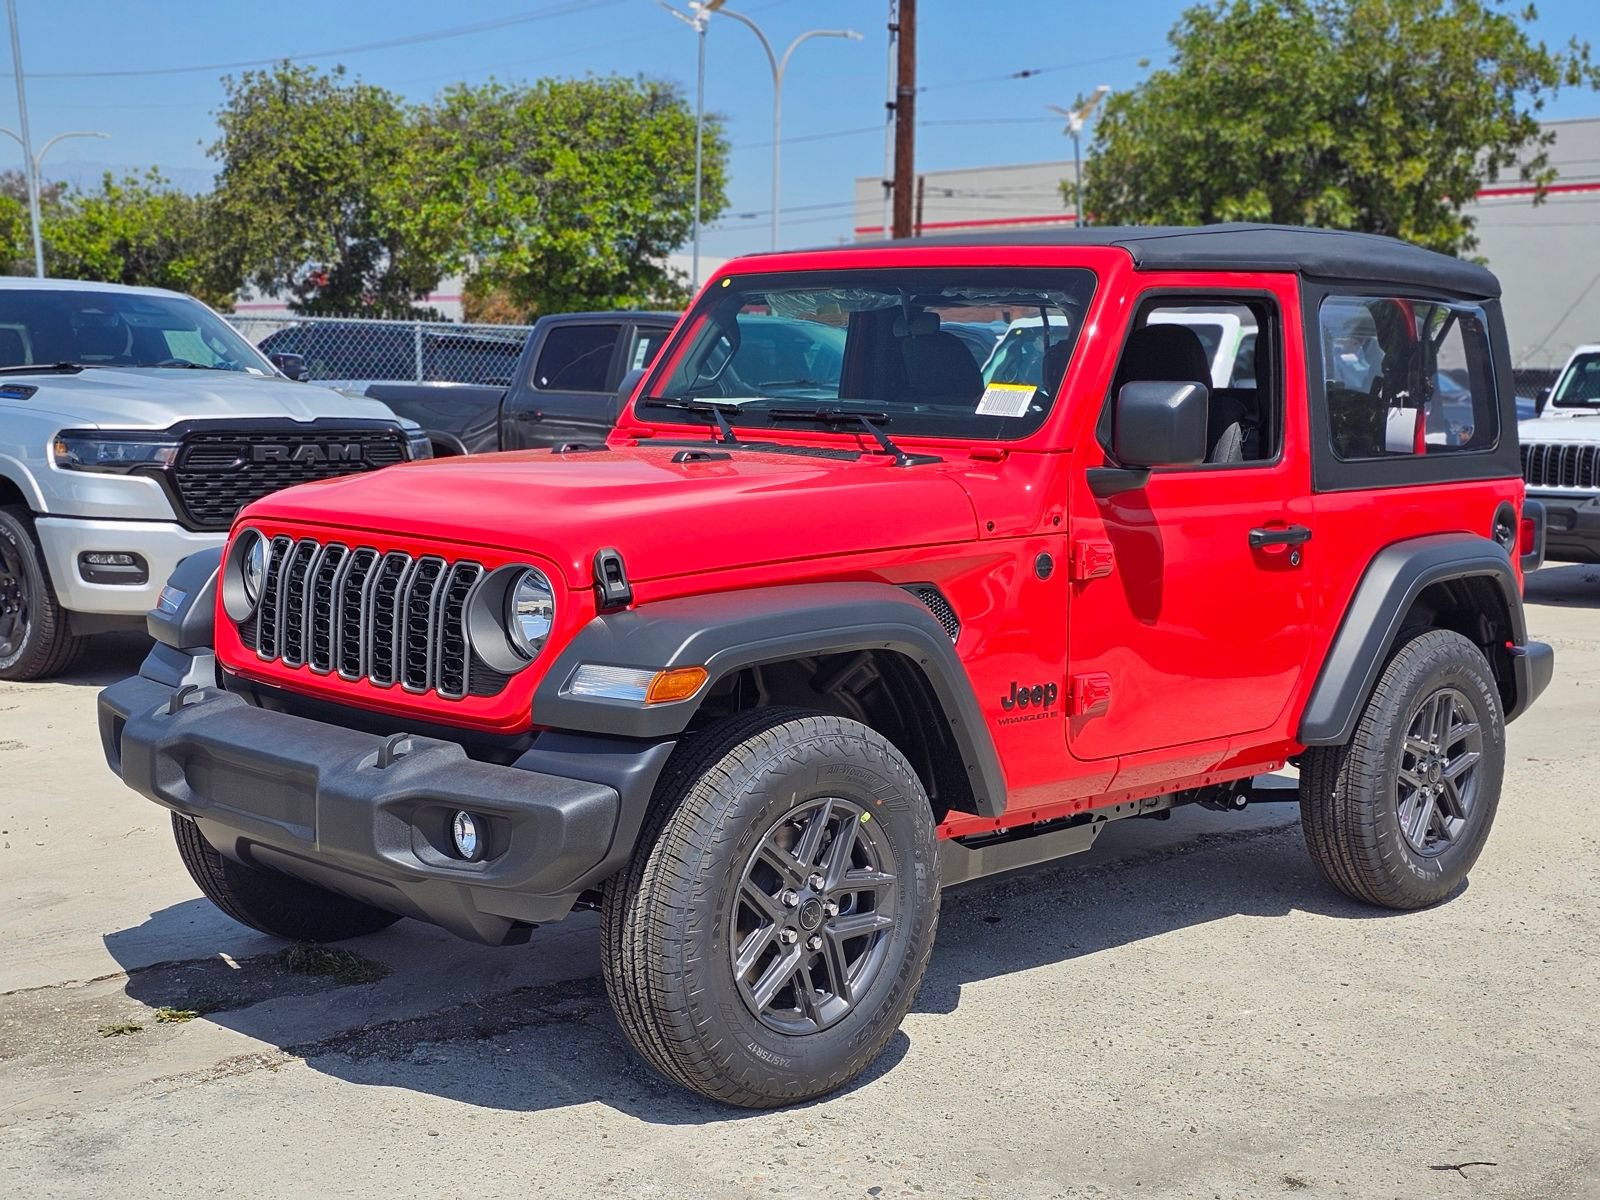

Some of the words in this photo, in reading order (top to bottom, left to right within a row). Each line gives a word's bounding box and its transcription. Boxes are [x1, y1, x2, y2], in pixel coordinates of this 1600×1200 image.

[252, 444, 361, 462] RAM
[1001, 682, 1058, 712] Jeep
[998, 712, 1049, 726] WRANGLER
[746, 1040, 792, 1067] 245/75R17
